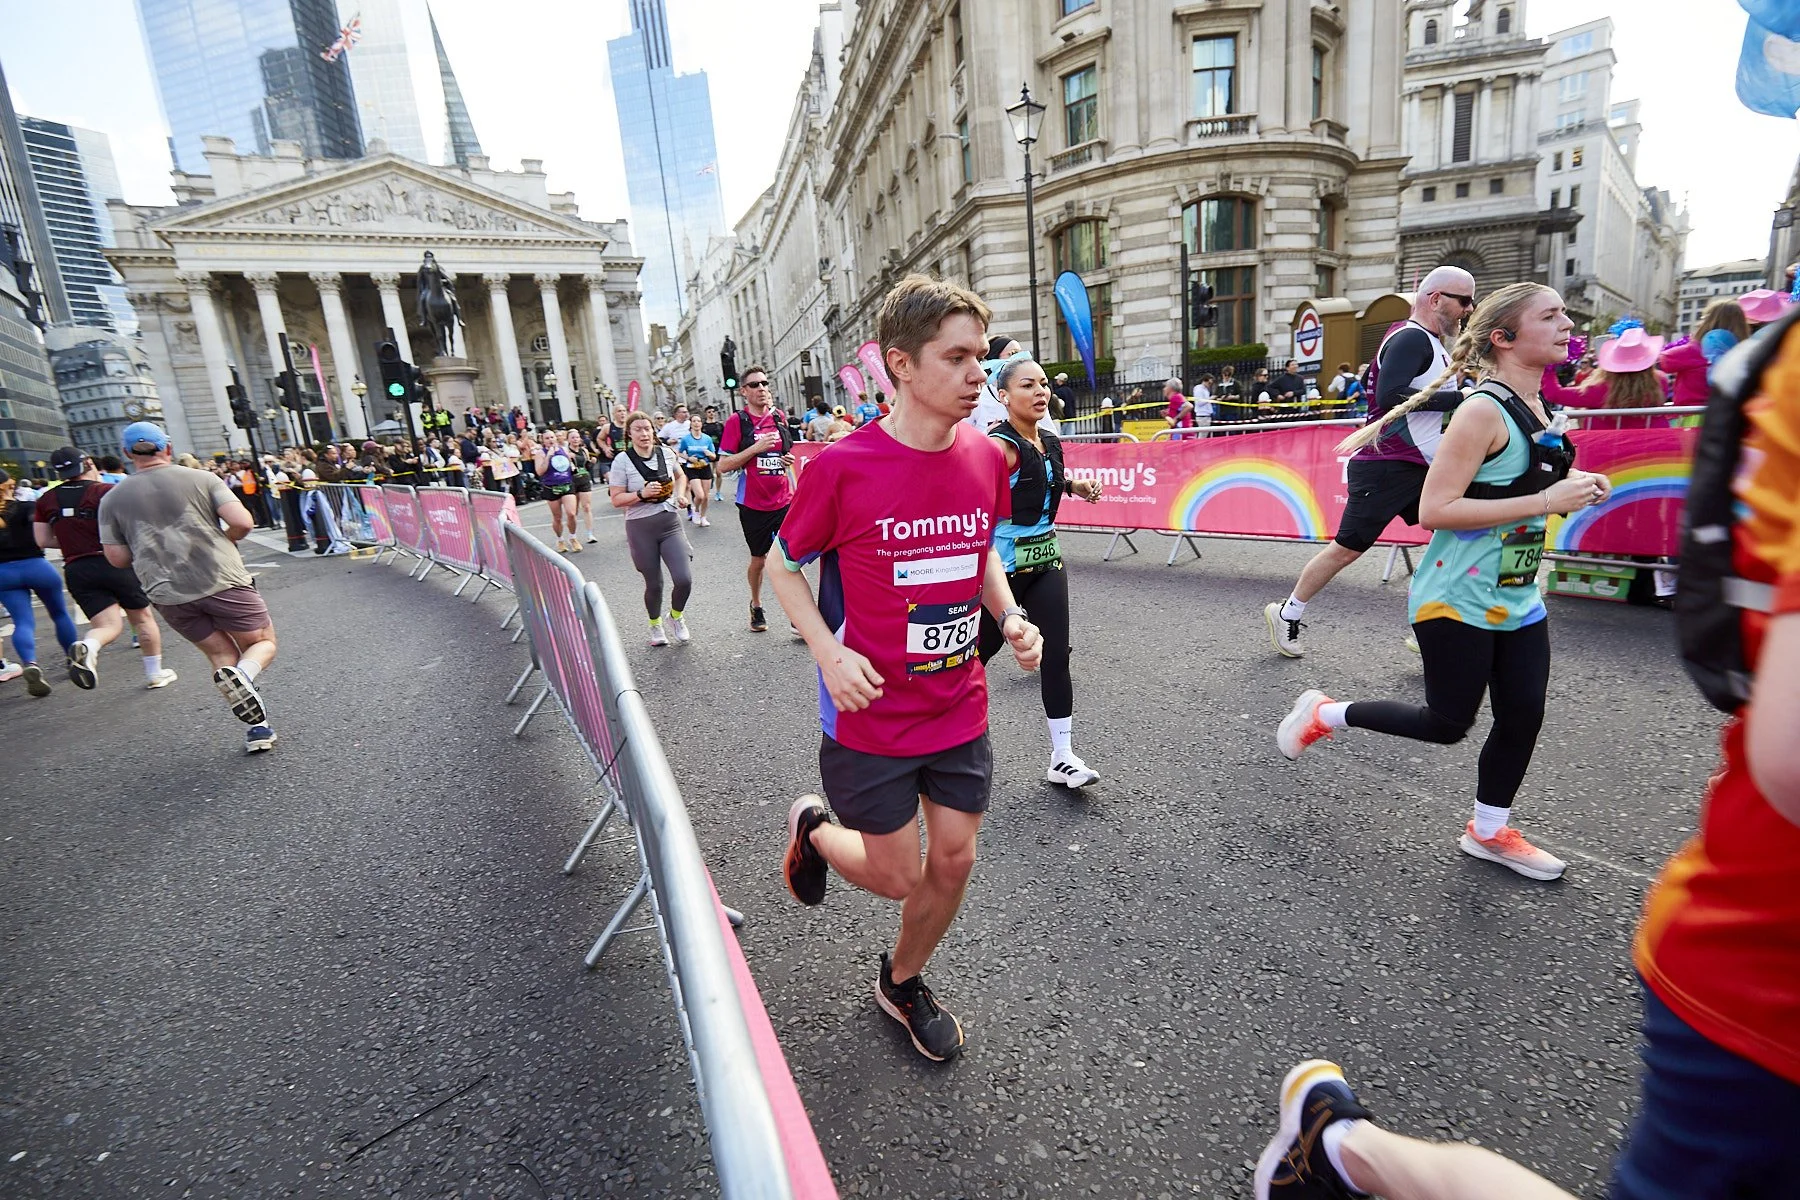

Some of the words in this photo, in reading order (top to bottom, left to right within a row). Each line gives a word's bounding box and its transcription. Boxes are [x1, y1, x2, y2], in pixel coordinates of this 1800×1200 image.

[1064, 462, 1157, 492] ommy's
[1109, 494, 1128, 504] baby
[1129, 495, 1157, 505] charity
[875, 507, 989, 541] Tommy's
[877, 549, 892, 557] The
[893, 545, 934, 558] pregnancy
[936, 541, 951, 552] and
[952, 540, 971, 551] baby
[1022, 542, 1056, 563] 7846
[1514, 546, 1543, 569] 784
[910, 568, 934, 576] MOORE
[948, 604, 968, 615] SEAN
[923, 615, 976, 651] 8787
